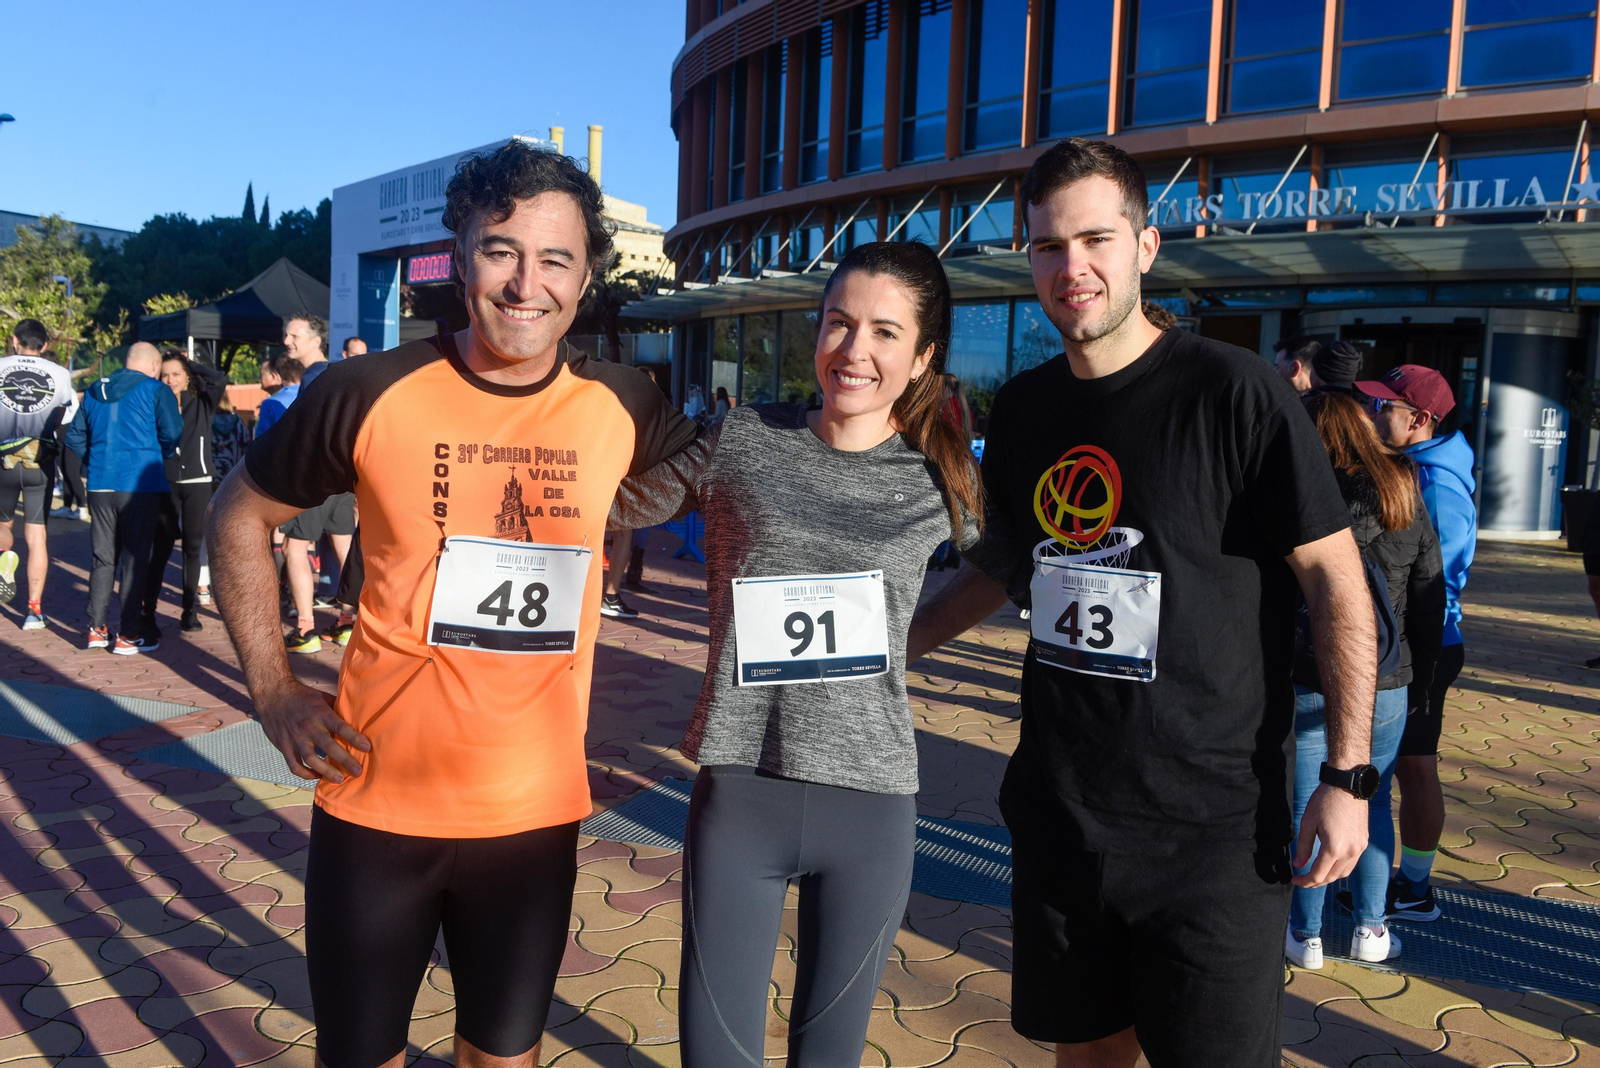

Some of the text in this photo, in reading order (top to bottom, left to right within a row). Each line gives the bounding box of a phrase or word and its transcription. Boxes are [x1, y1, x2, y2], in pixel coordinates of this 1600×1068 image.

[1237, 186, 1357, 220] TORRE
[1375, 176, 1546, 214] SEVILLA
[1523, 429, 1567, 438] EUROSTARS
[528, 468, 578, 482] VALLE
[543, 486, 565, 500] DE
[524, 505, 581, 519] LA OSA
[496, 552, 548, 567] CARRERA VERTICAL
[1062, 574, 1109, 590] CARRERA VERTICAL
[783, 585, 835, 597] CARRERA VERTICAL
[476, 580, 550, 628] 48
[1055, 600, 1114, 650] 43
[784, 610, 837, 658] 91
